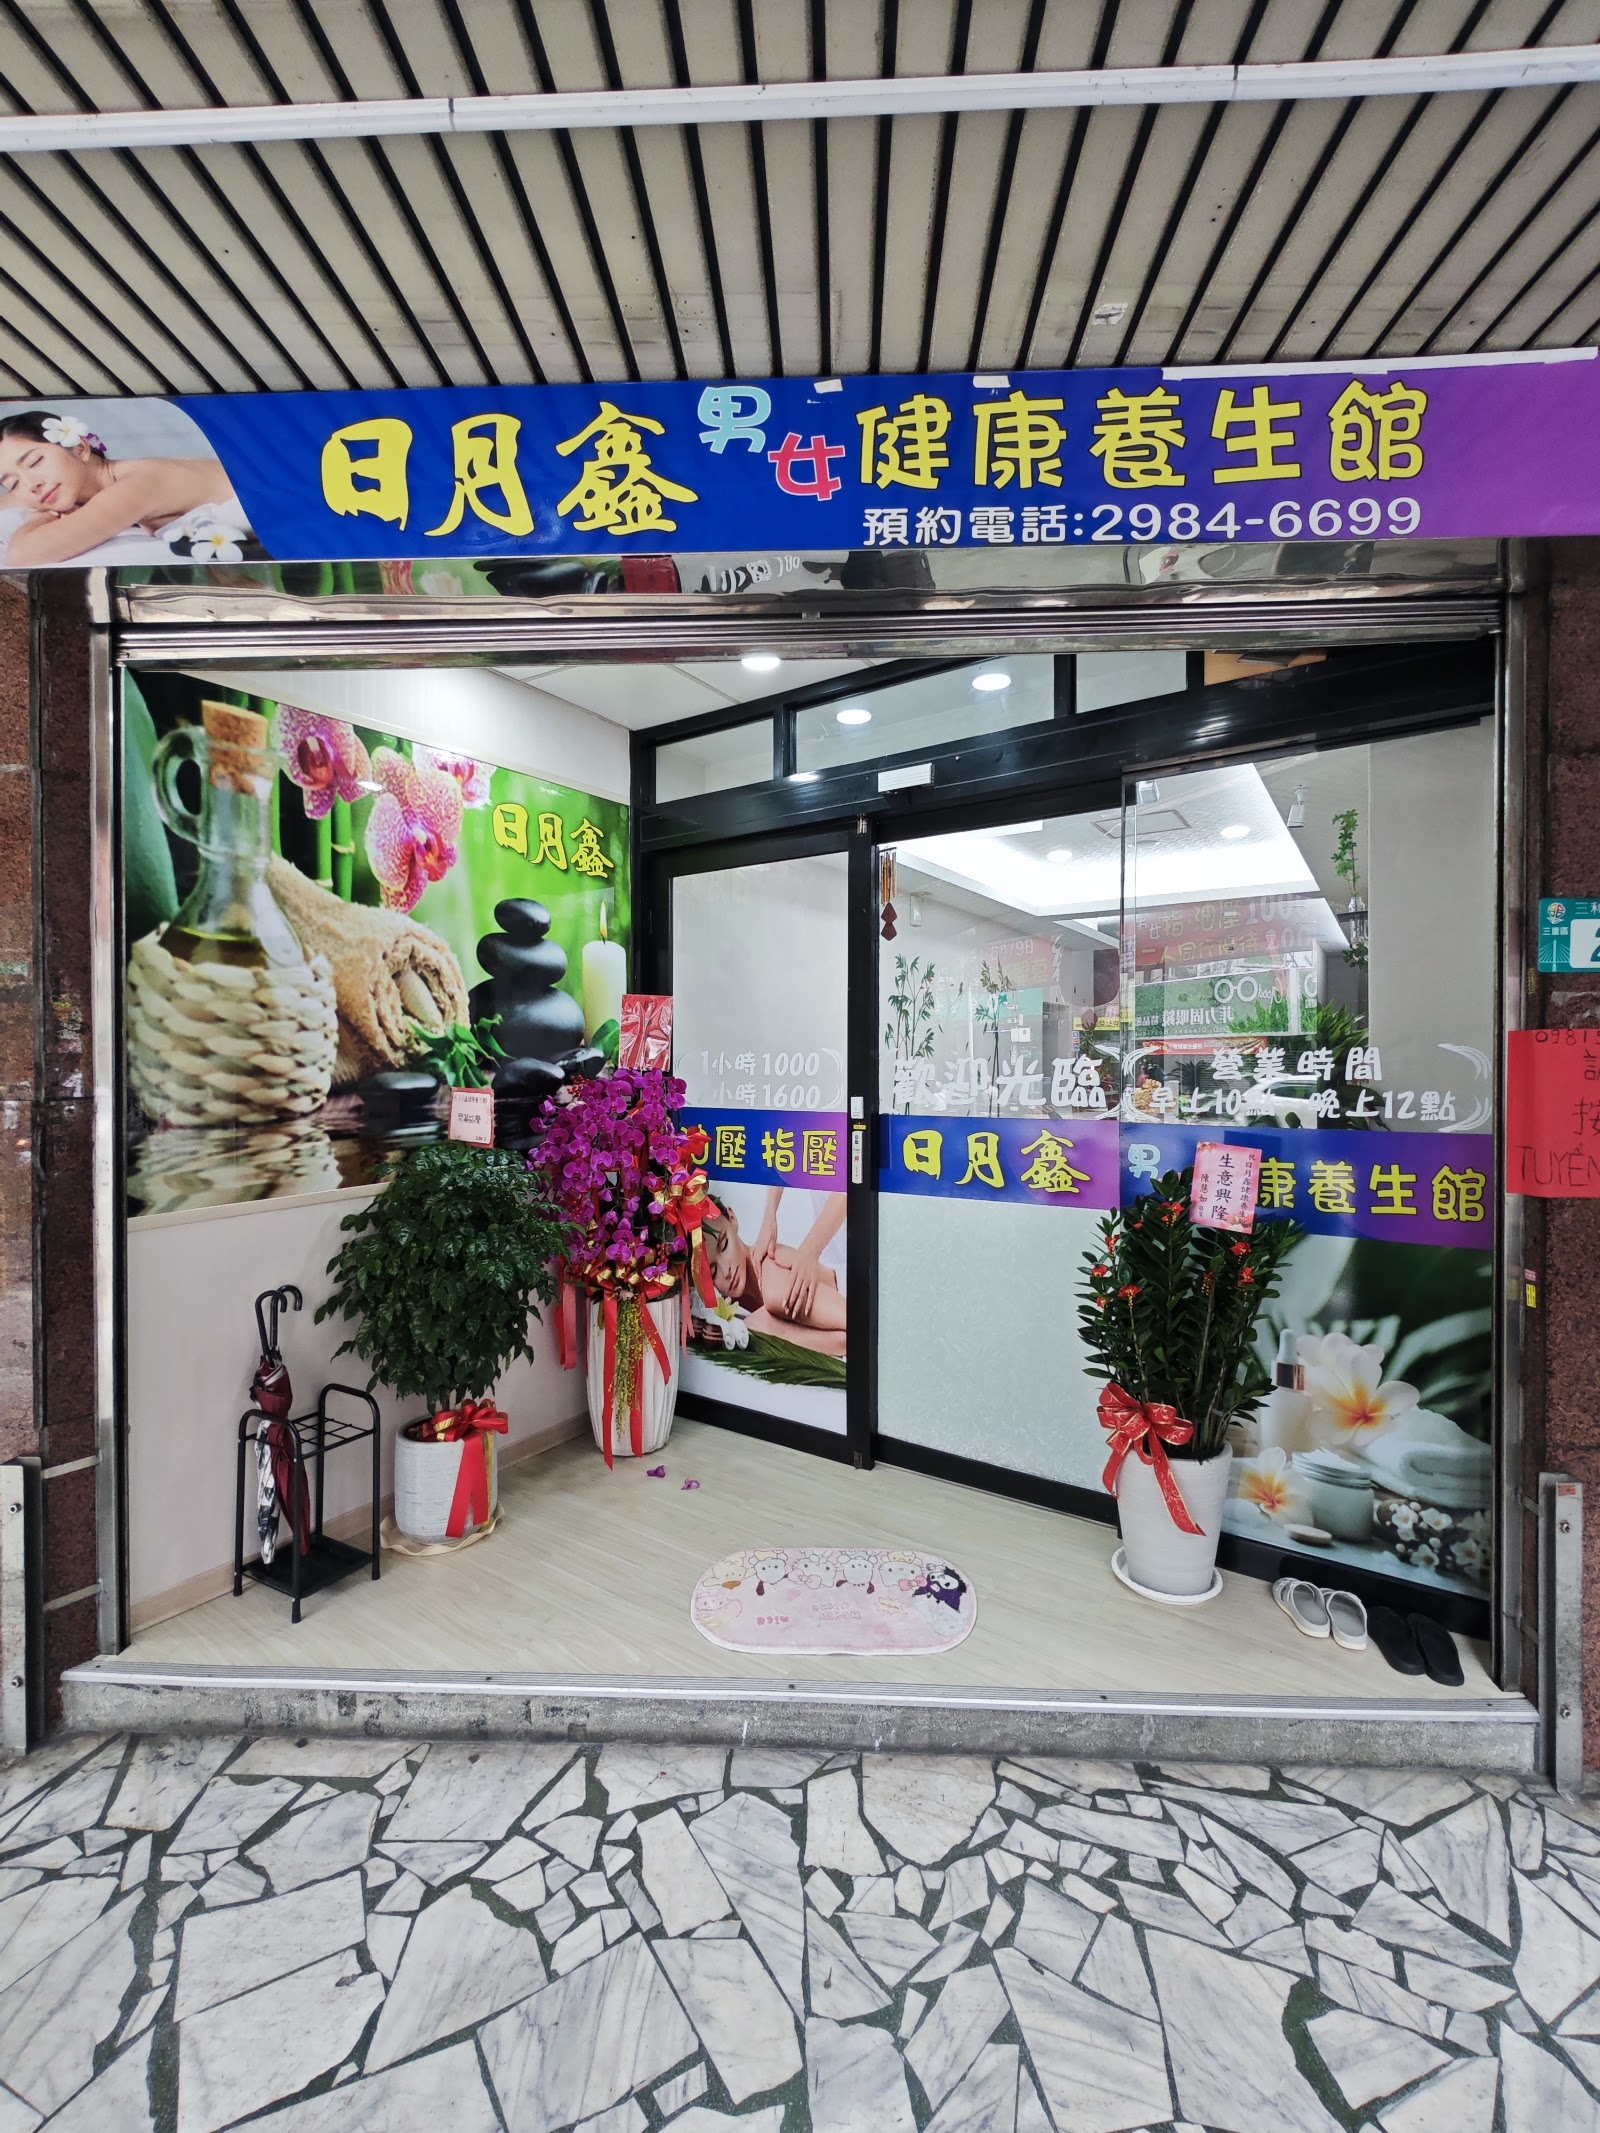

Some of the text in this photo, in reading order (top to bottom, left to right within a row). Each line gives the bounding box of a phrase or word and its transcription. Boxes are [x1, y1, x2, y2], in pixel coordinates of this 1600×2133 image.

[321, 379, 1428, 538] 日月鑫 男女 健康養生館
[863, 497, 1422, 546] 預約電話:2984-6699
[491, 802, 615, 878] 日月鑫
[892, 1054, 1106, 1108] 歡迎光臨
[1211, 1046, 1383, 1082] 營業時間
[1308, 1088, 1456, 1122] 晚上12點
[902, 1129, 1091, 1194] 日月鑫
[1211, 1152, 1235, 1222] 生意興隆
